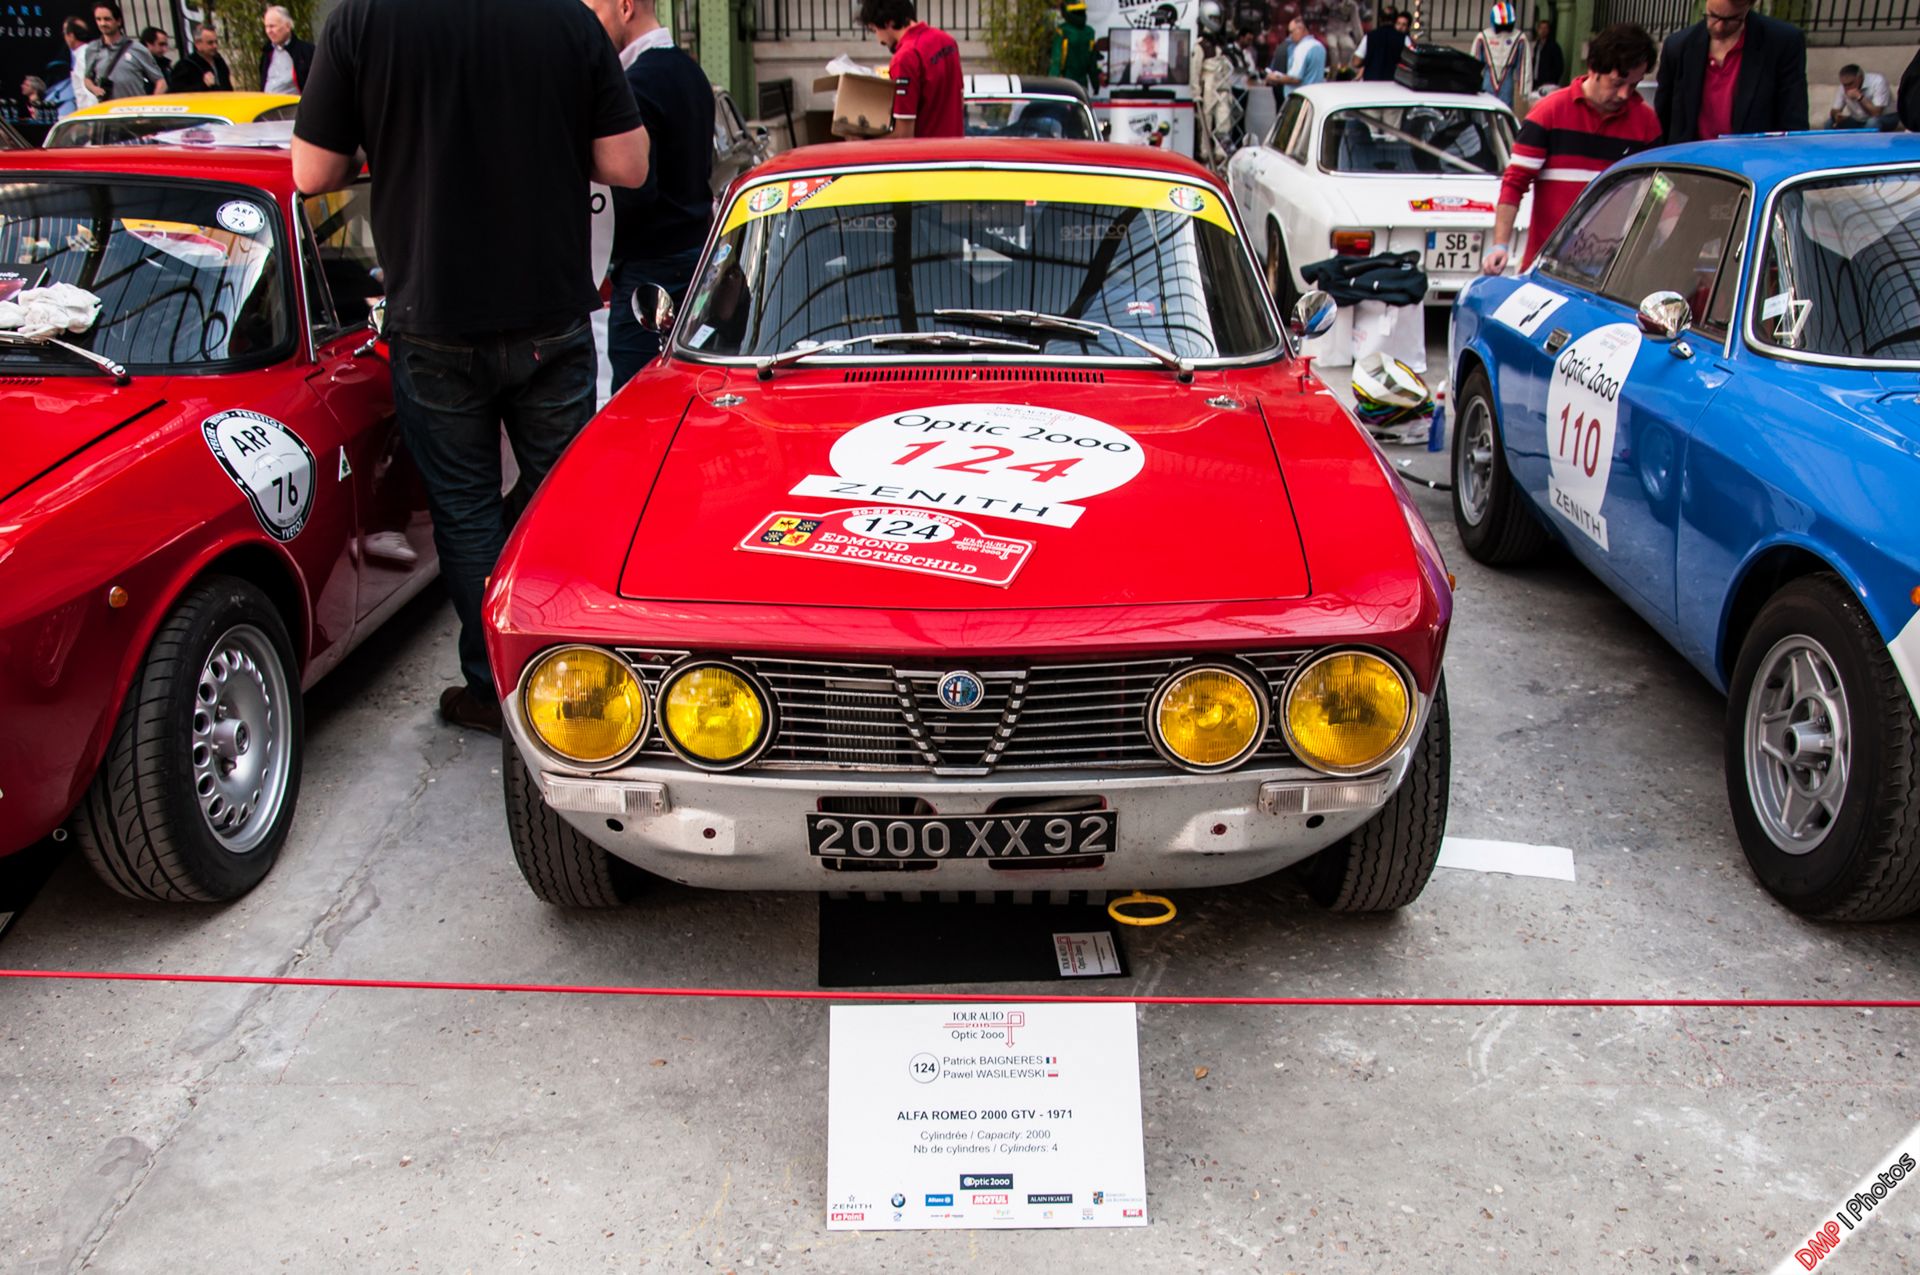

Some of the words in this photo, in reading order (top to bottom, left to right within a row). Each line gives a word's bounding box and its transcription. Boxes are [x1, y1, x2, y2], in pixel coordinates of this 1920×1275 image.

[0, 6, 42, 16] ARE
[233, 207, 254, 215] ARP
[231, 217, 246, 227] 76
[1445, 234, 1467, 250] SB
[1435, 252, 1457, 269] AT
[1461, 252, 1471, 269] 1
[1559, 348, 1590, 387] Optic
[1587, 362, 1619, 402] 2000
[893, 414, 1011, 437] Optic
[1020, 426, 1131, 453] 2000
[230, 425, 271, 457] ARP
[1560, 402, 1601, 478] 110
[891, 440, 1085, 484] 124
[271, 472, 299, 514] 76
[829, 482, 1050, 518] ZENITH
[892, 509, 931, 520] AVRIL
[1555, 488, 1602, 540] ZENITH
[865, 517, 940, 540] 124
[818, 532, 910, 552] EDMOND
[809, 543, 839, 554] DE
[842, 545, 978, 575] ROTHSCHILD
[815, 818, 951, 857] 2000
[965, 819, 1031, 857] XX
[1044, 816, 1109, 853] 92
[953, 1011, 977, 1021] TOUR
[979, 1011, 1004, 1021] AUTO
[951, 1030, 978, 1042] Optic
[980, 1030, 1005, 1039] 2000
[943, 1056, 977, 1065] Patrick
[979, 1056, 1043, 1065] BAIGNERES
[913, 1062, 936, 1074] 124
[943, 1069, 973, 1079] Pawel
[976, 1069, 1045, 1079] WASILEWSKI
[897, 1110, 929, 1121] ALFA
[932, 1110, 978, 1120] ROMEO
[980, 1110, 1008, 1120] 2000
[1011, 1109, 1036, 1119] GTV
[1047, 1109, 1073, 1119] 1971
[920, 1131, 968, 1142] Cylindrée
[977, 1130, 1023, 1141] Capacity:
[1026, 1130, 1051, 1140] 2000
[913, 1144, 928, 1154] Nb
[931, 1144, 943, 1154] de
[946, 1144, 990, 1155] cylindres
[999, 1143, 1049, 1155] Cylinders:
[1051, 1143, 1058, 1152] 4
[967, 1177, 989, 1187] Optic
[990, 1177, 1010, 1186] 2000
[974, 1195, 1007, 1204] MOTUL
[1030, 1195, 1047, 1203] ALAIN
